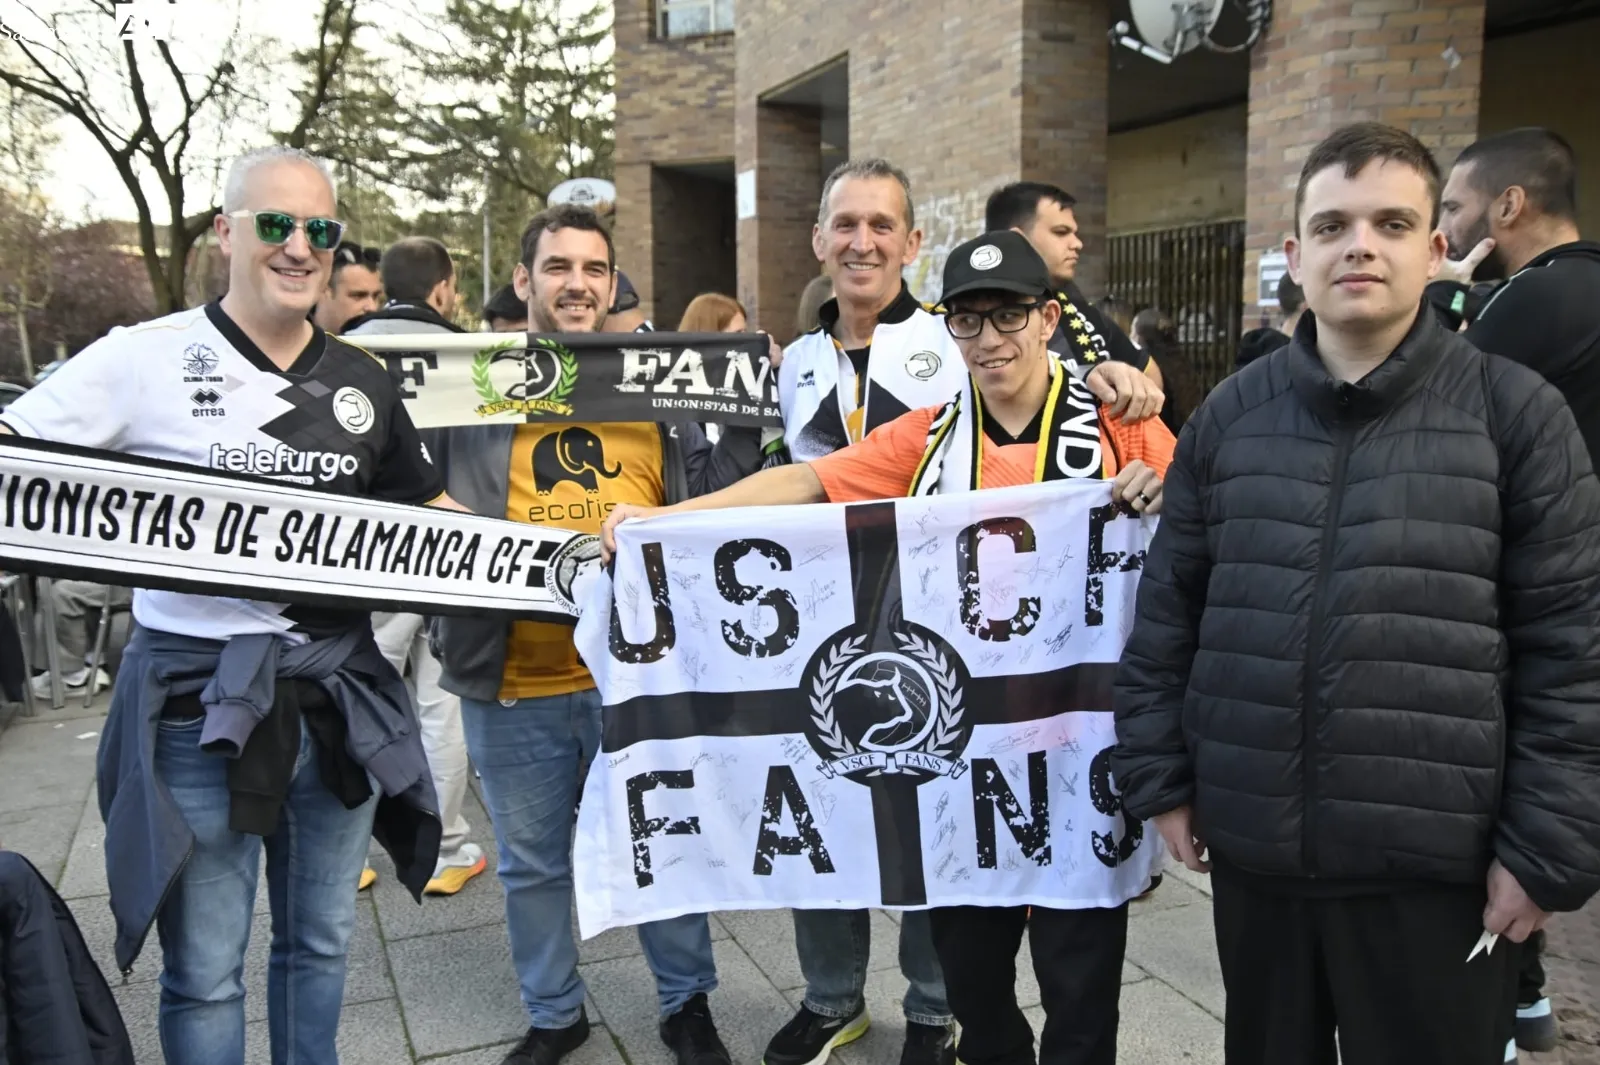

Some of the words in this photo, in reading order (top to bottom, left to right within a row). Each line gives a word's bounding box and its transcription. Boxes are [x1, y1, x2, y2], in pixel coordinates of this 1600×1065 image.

[652, 398, 737, 414] UNIONISTAS
[742, 405, 759, 416] DE
[210, 442, 358, 482] telefurgo
[0, 474, 204, 551] IONISTAS
[214, 502, 269, 558] DE
[275, 509, 482, 581] SALAMANCA
[487, 536, 533, 584] CF
[905, 753, 943, 771] FANS
